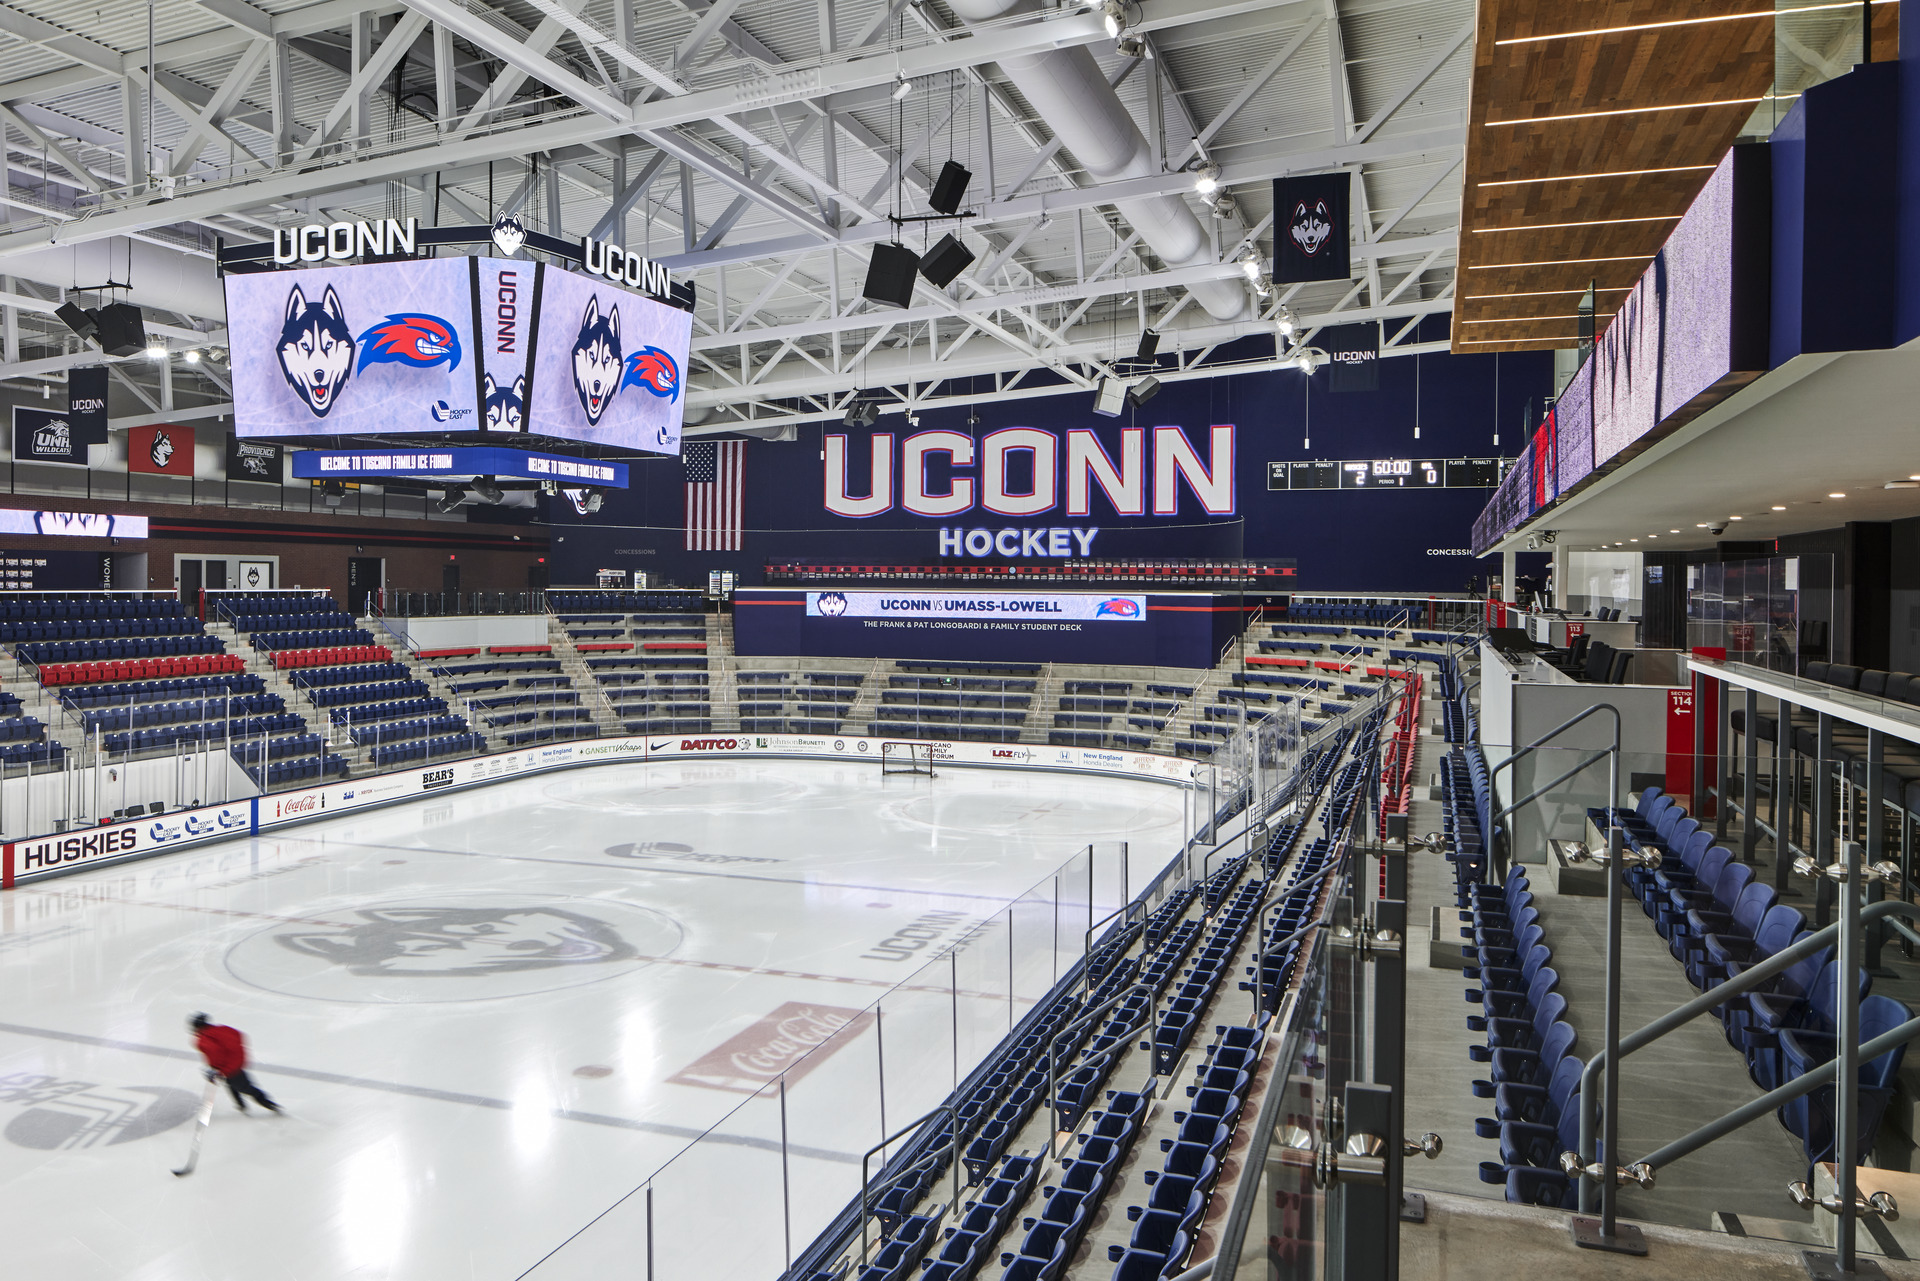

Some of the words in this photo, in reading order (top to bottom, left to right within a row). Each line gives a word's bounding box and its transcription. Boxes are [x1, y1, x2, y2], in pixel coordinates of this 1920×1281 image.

[274, 217, 418, 264] UCONN
[582, 236, 671, 299] UCONN
[497, 270, 517, 354] UCONN
[1334, 350, 1376, 362] UCONN
[72, 398, 105, 410] UCONN
[36, 433, 70, 448] UNH
[240, 444, 274, 456] PROVIDENCE
[320, 456, 350, 470] WELCOME
[352, 456, 360, 470] TO
[362, 456, 391, 470] TOSCANO
[392, 455, 416, 469] FAMILY
[418, 455, 428, 469] ICE
[430, 454, 452, 468] FORUM
[1374, 461, 1410, 474] 60:00
[824, 425, 1235, 518] UCONN
[1356, 471, 1365, 485] 2
[1427, 470, 1437, 483] 0
[939, 528, 1098, 556] HOCKEY
[880, 600, 931, 610] UCONN
[933, 600, 942, 610] VS
[945, 601, 1062, 612] UMASS-LOWELL
[1673, 696, 1692, 706] 114
[680, 740, 737, 750] DATTCO
[423, 768, 454, 783] BEAR'S
[24, 828, 137, 870] HUSKIES
[859, 909, 970, 962] UCONN
